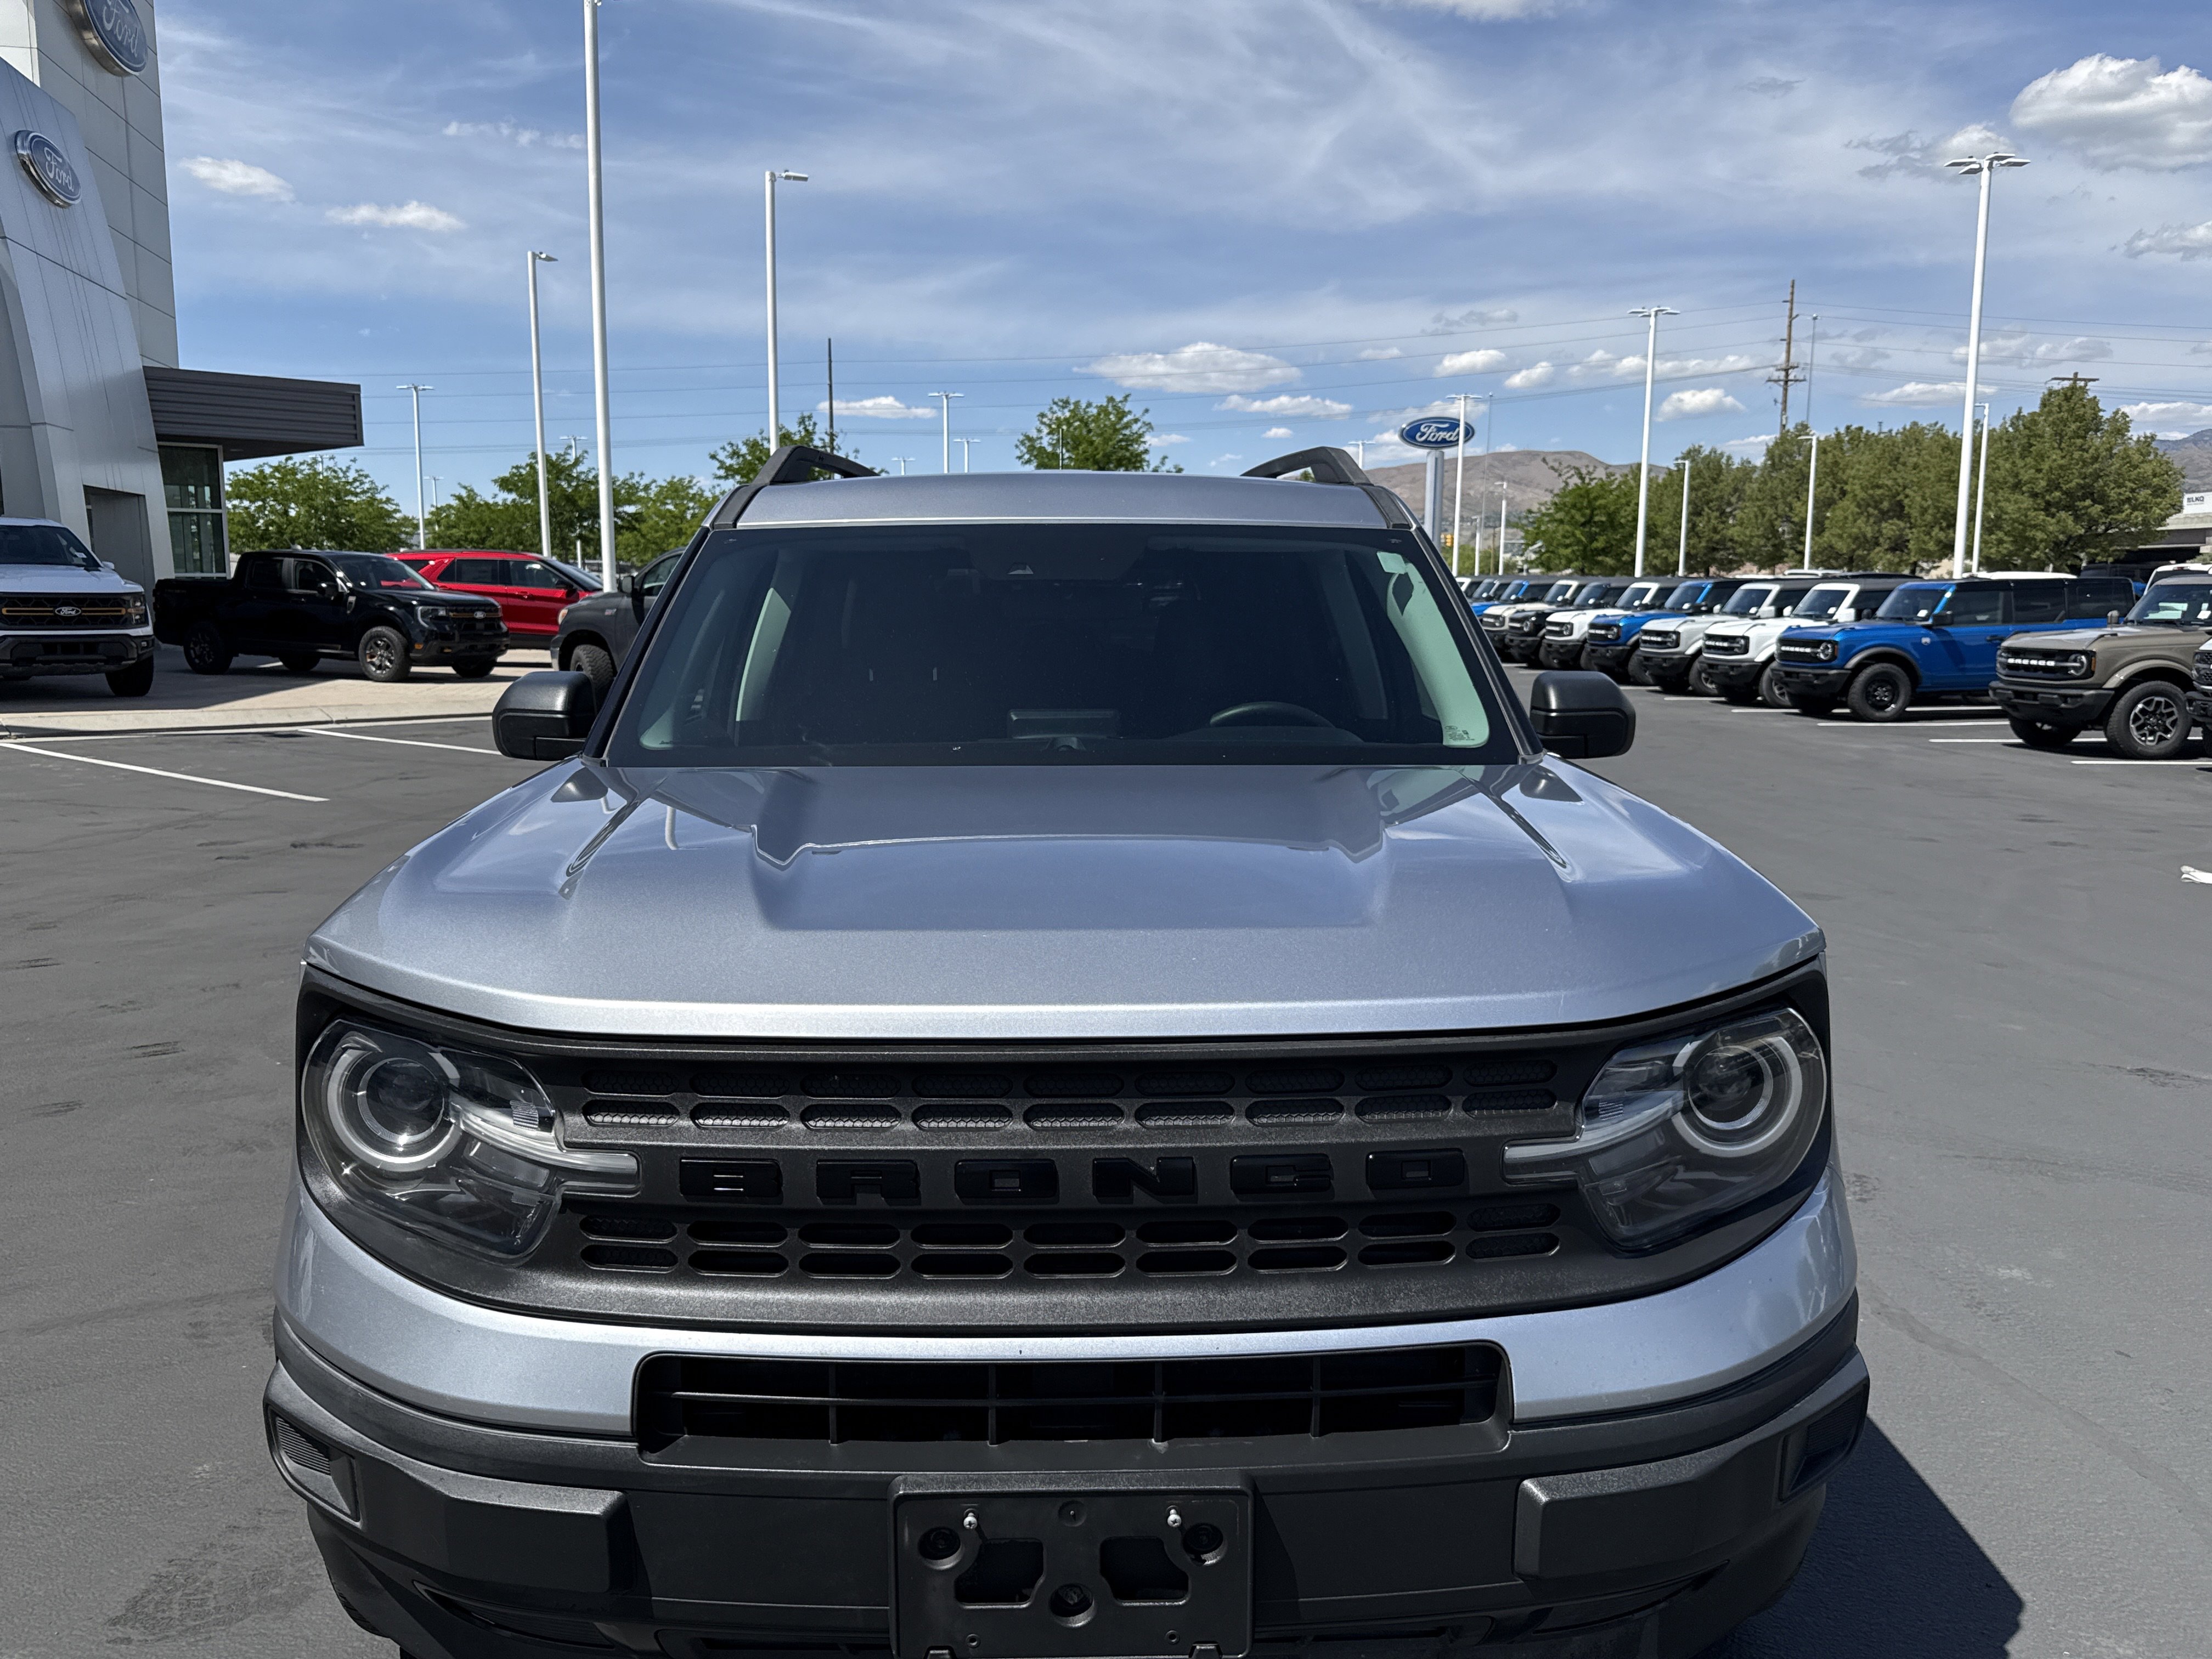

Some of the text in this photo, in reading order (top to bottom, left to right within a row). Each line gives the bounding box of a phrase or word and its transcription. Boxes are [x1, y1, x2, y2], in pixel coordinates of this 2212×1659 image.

[103, 0, 138, 58] Ford
[44, 146, 74, 193] Ford
[1415, 422, 1460, 442] Ford
[679, 1148, 1466, 1201] BRONCO
